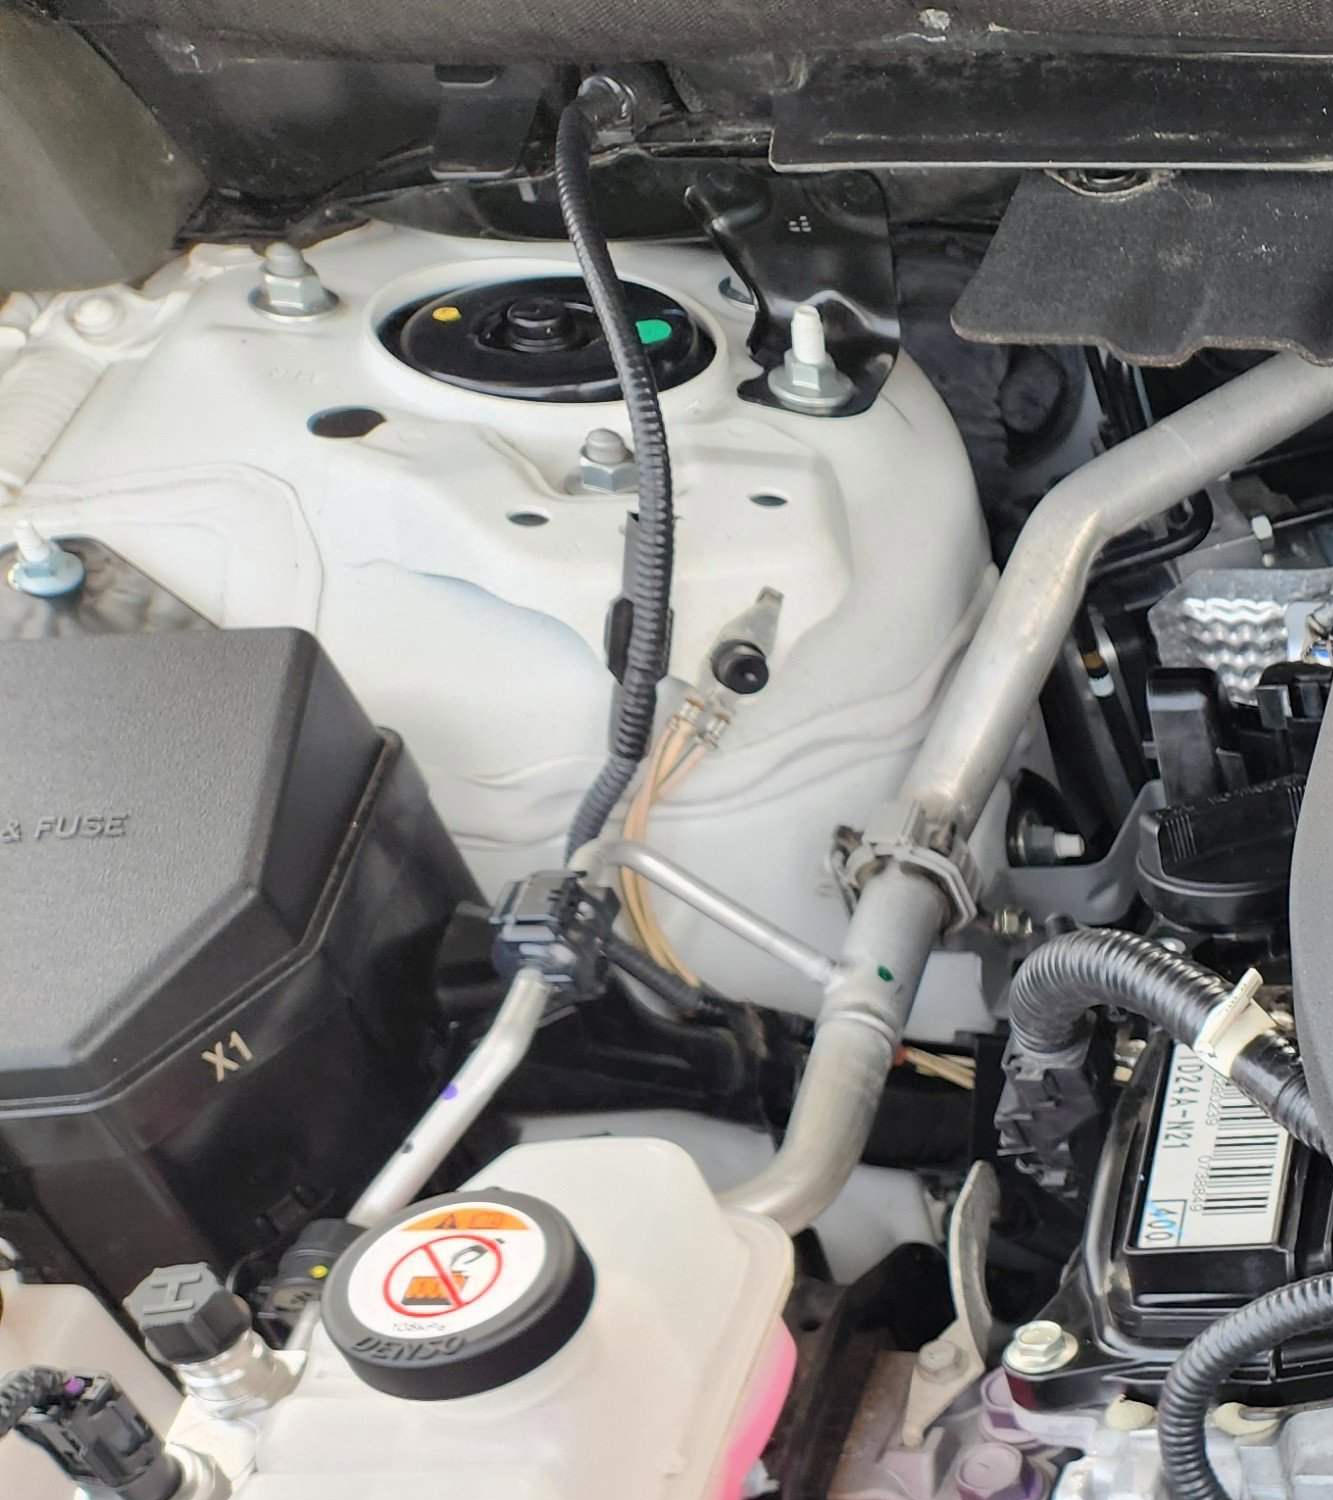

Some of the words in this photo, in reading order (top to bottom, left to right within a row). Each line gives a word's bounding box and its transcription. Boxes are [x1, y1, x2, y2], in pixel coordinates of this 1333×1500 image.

[34, 812, 130, 842] FUSE
[201, 1030, 252, 1083] X1
[351, 1336, 467, 1362] DENSO
